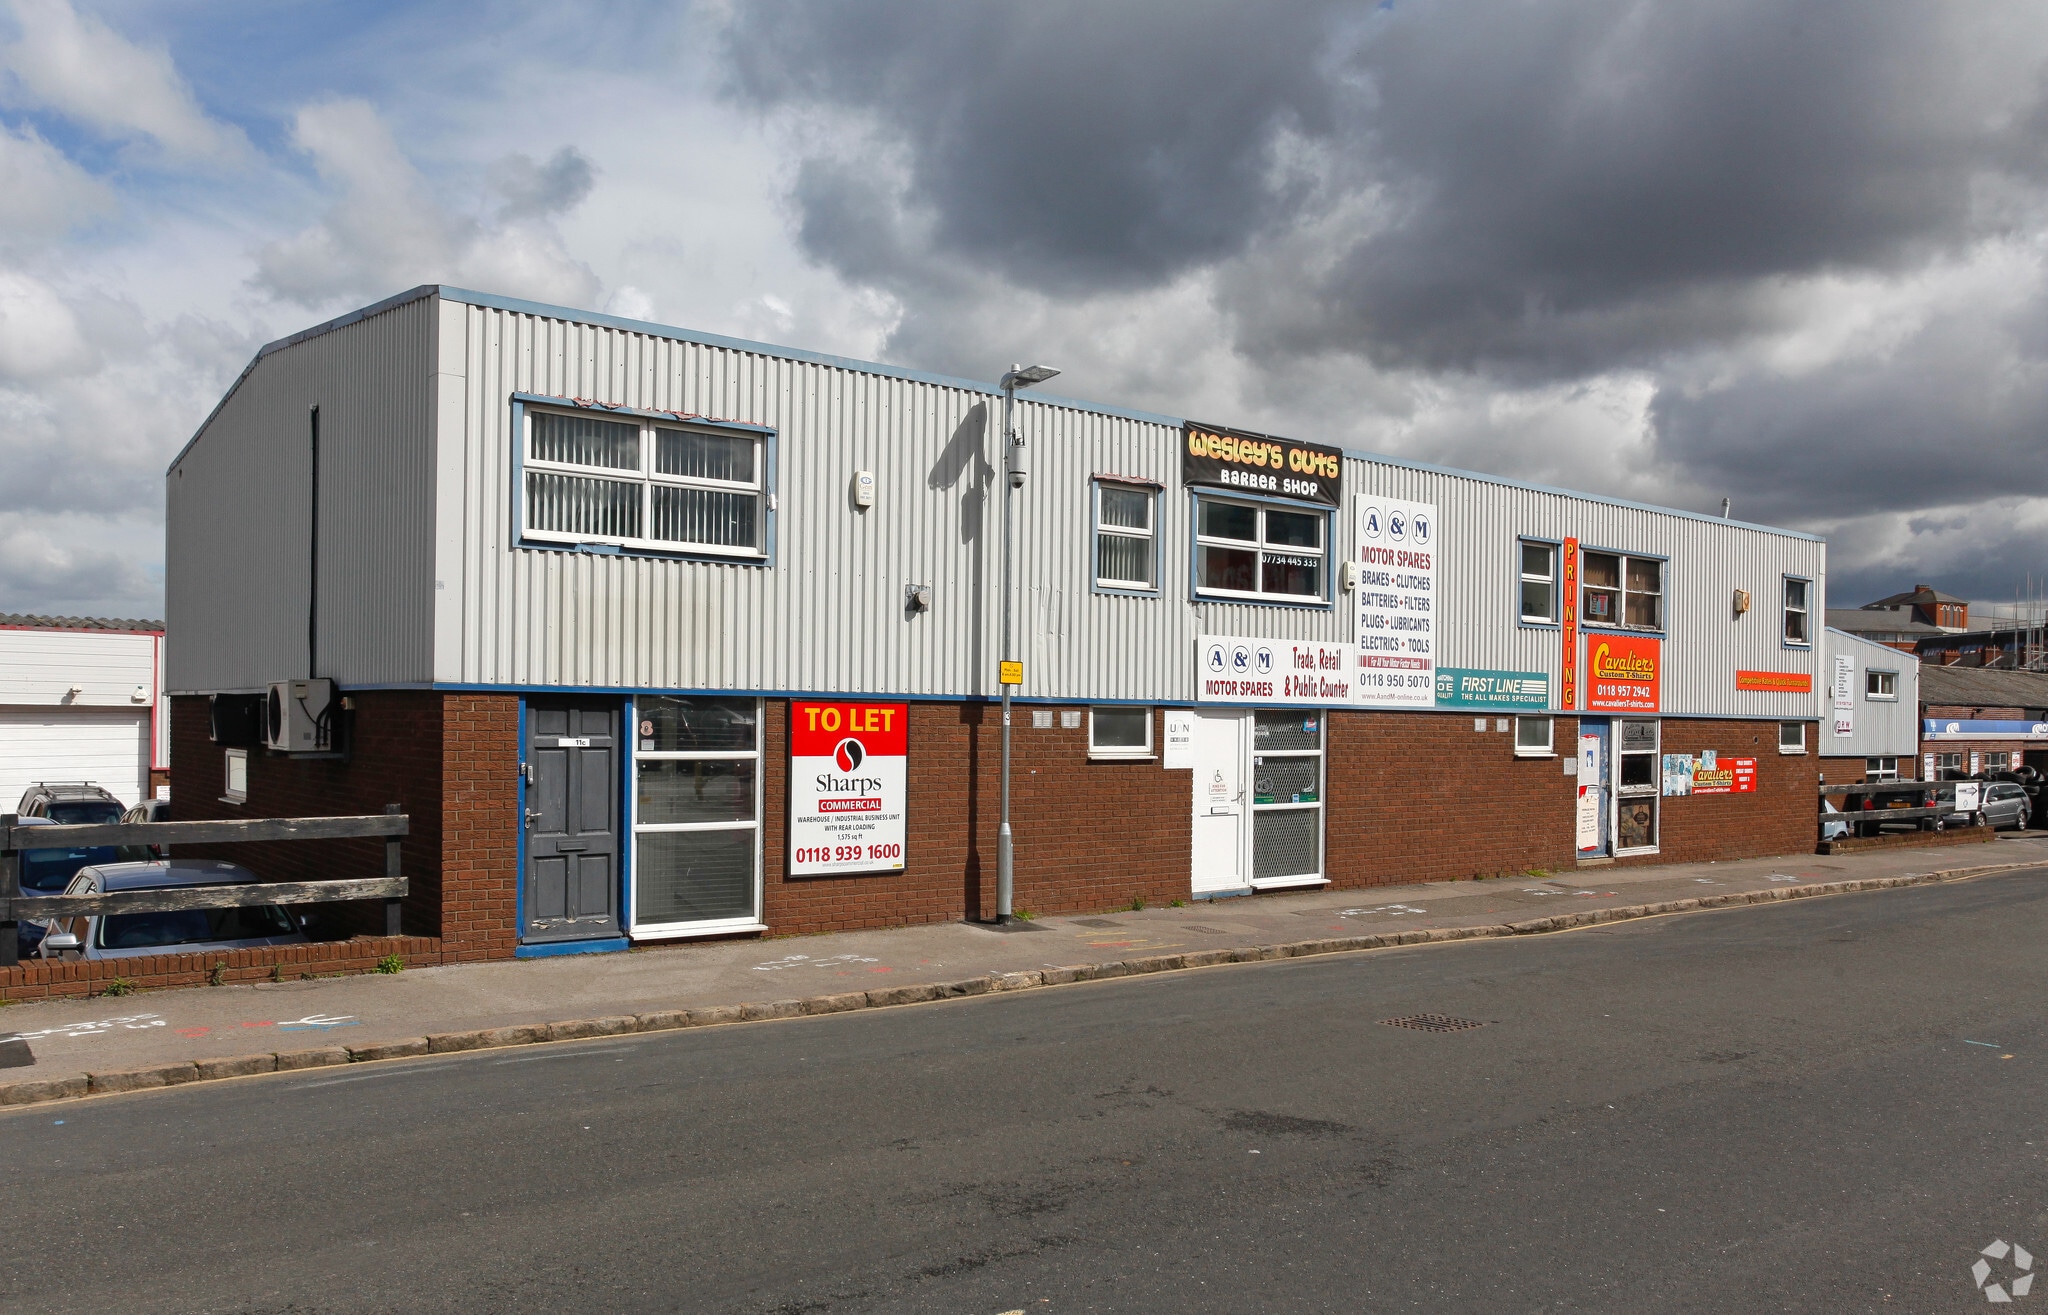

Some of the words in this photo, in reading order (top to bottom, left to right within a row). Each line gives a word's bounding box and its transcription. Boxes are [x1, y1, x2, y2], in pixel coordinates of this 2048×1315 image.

[1283, 478, 1318, 497] SHOP
[1367, 514, 1379, 531] A
[1390, 517, 1405, 535] &
[1415, 520, 1428, 538] M
[1262, 554, 1286, 566] 07734
[1287, 556, 1302, 567] 445
[1303, 557, 1317, 568] 333
[1361, 545, 1395, 567] MOTOR
[1397, 549, 1431, 571] SPARES
[1362, 570, 1390, 587] BRAKES
[1396, 573, 1431, 591] CLUTCHES
[1361, 591, 1398, 609] BATTERIES
[1404, 595, 1431, 612] FILTERS
[1361, 613, 1385, 629] PLUGS
[1390, 615, 1430, 632] LUBRICANTS
[1565, 543, 1574, 704] PRINTING
[1361, 634, 1399, 652] ELECTRICS
[1407, 638, 1430, 653] TOOLS
[1211, 651, 1223, 666] A
[1233, 651, 1248, 667] &
[1258, 653, 1270, 668] M
[1293, 646, 1316, 673] Trade,
[1319, 647, 1342, 671] Retail
[1594, 642, 1654, 675] Cavaliers
[1206, 680, 1238, 697] MOTOR
[1239, 681, 1273, 697] SPARES
[1284, 675, 1291, 698] &
[1294, 675, 1317, 698] Public
[1319, 676, 1349, 698] Counter
[1360, 673, 1384, 687] 0118
[1386, 674, 1405, 688] 950
[1407, 675, 1430, 689] 5070
[1461, 676, 1494, 692] FIRST
[1495, 678, 1522, 694] LINE
[1361, 692, 1428, 701] www.AandM-online.co.uk
[1475, 693, 1487, 701] ALL
[1489, 694, 1510, 702] MAKES
[1511, 695, 1546, 703] SPECIALIST
[1597, 684, 1616, 696] 0118
[1617, 685, 1631, 697] 957
[1632, 685, 1650, 698] 2942
[804, 707, 841, 732] TO
[849, 708, 896, 733] LET
[816, 774, 882, 796] Sharps
[820, 800, 881, 811] COMMERCIAL
[797, 815, 830, 823] WAREHOUSE
[835, 814, 864, 822] INDUSTRIAL
[865, 813, 888, 821] BUSINESS
[824, 824, 838, 832] WITH
[796, 847, 831, 864] 0118
[835, 845, 862, 861] 939
[867, 843, 901, 860] 1600
